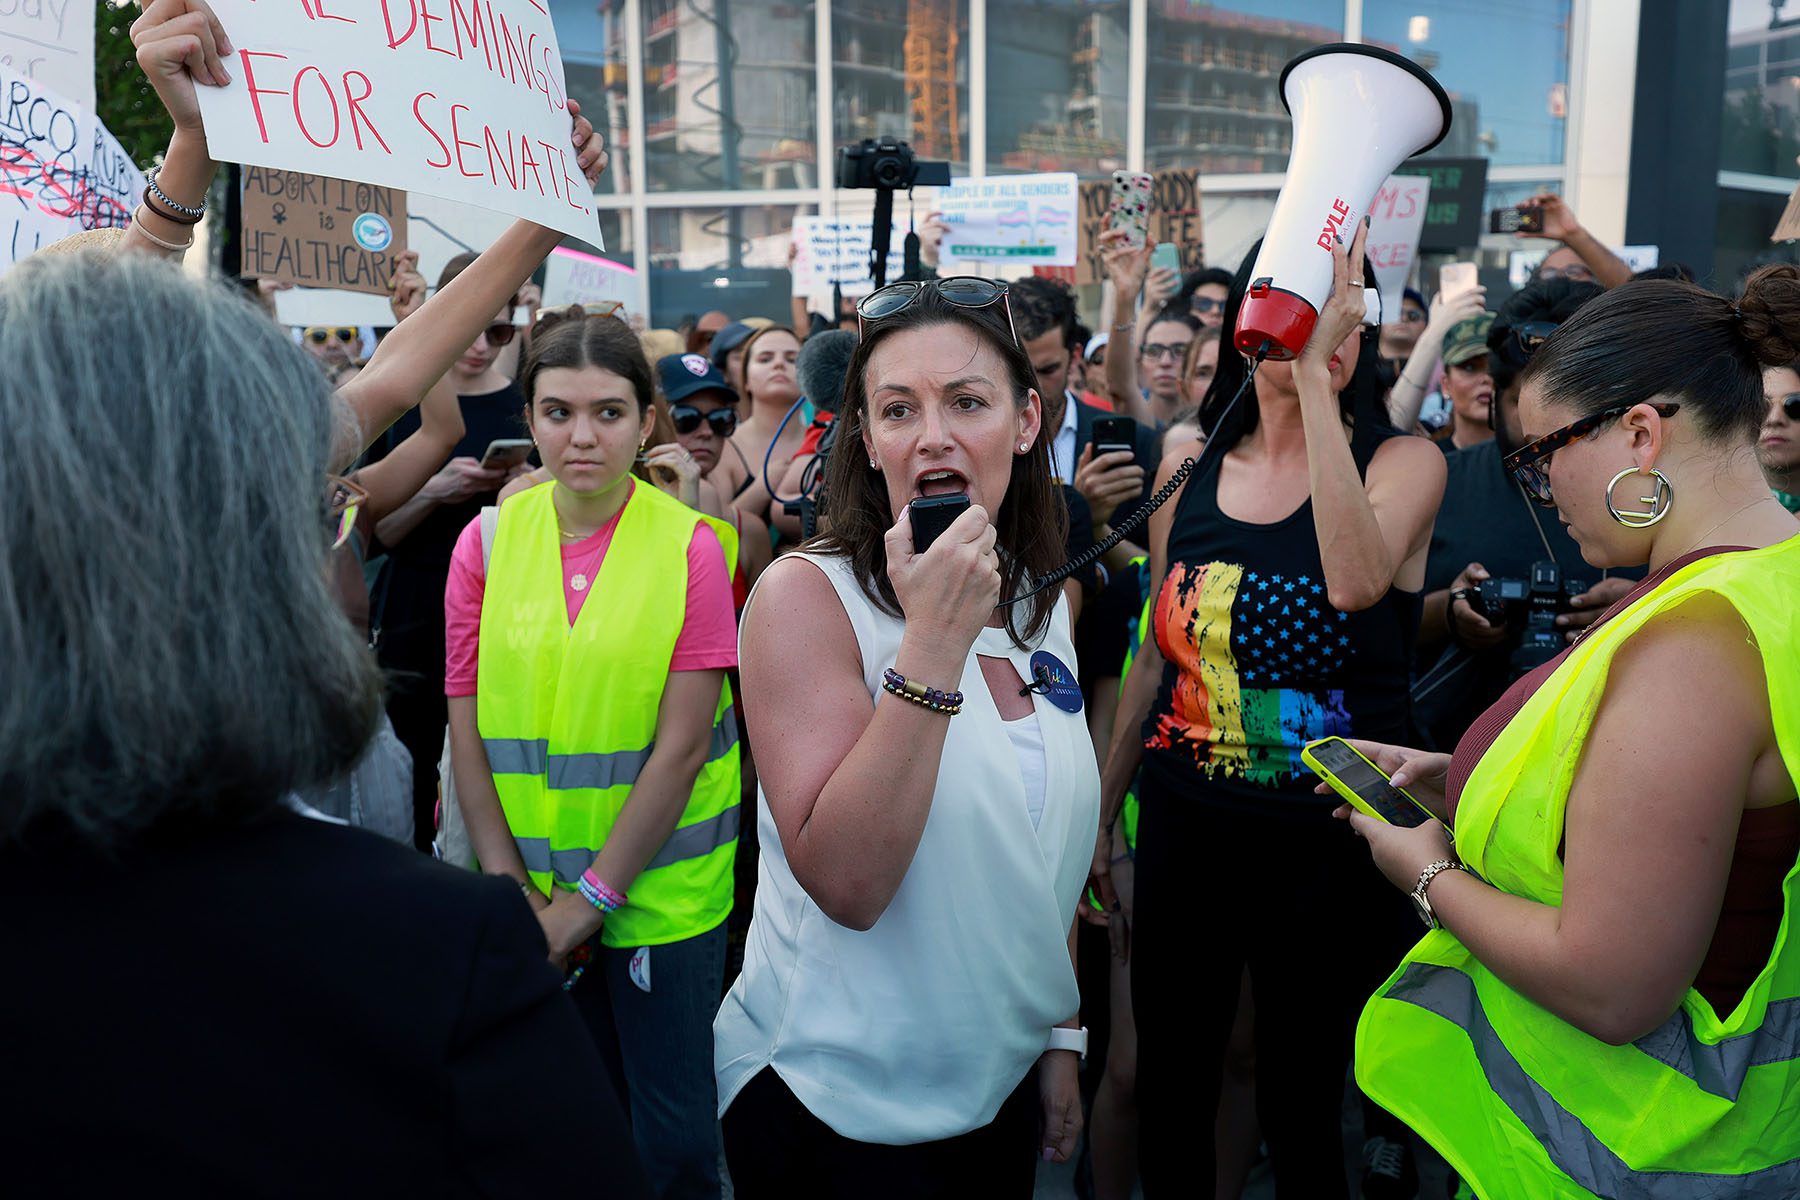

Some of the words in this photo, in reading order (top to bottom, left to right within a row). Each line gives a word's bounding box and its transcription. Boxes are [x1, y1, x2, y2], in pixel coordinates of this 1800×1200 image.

[387, 0, 565, 113] DEMINGS
[239, 48, 391, 154] FOR
[412, 92, 590, 215] SENATE.
[245, 166, 393, 217] ABORTION
[319, 211, 335, 230] is
[1317, 197, 1350, 252] PYLE
